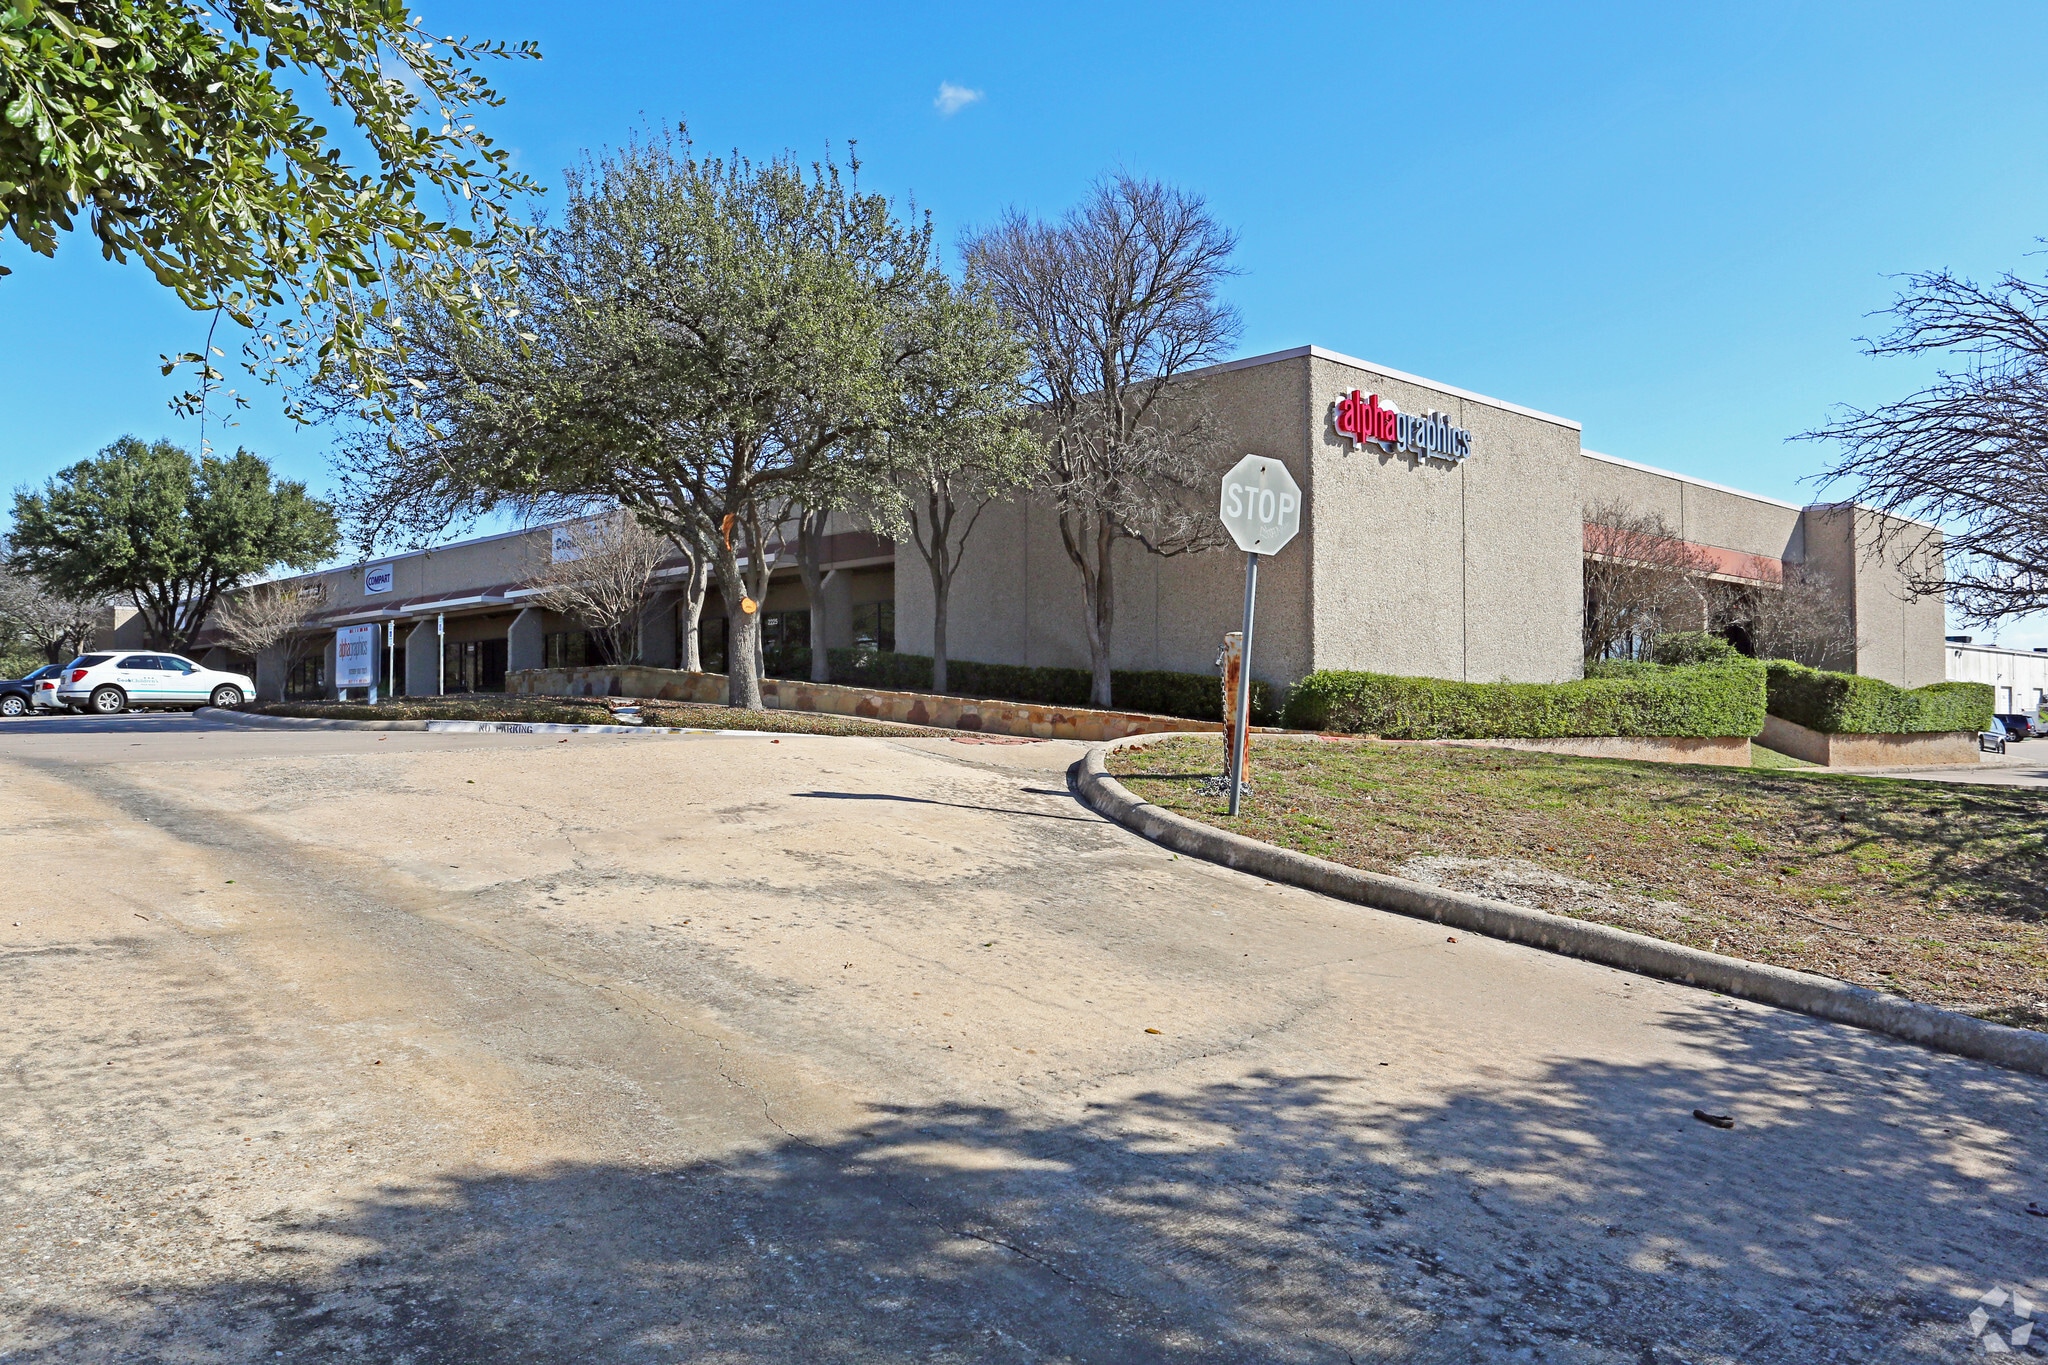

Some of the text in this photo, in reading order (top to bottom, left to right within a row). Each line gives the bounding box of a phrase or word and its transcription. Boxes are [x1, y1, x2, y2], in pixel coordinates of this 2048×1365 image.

[1336, 390, 1471, 459] alphagraphics
[1227, 483, 1295, 525] STOP
[368, 573, 391, 586] COMPART
[339, 636, 368, 661] alphagraphics
[478, 723, 533, 734] NO PARKING
